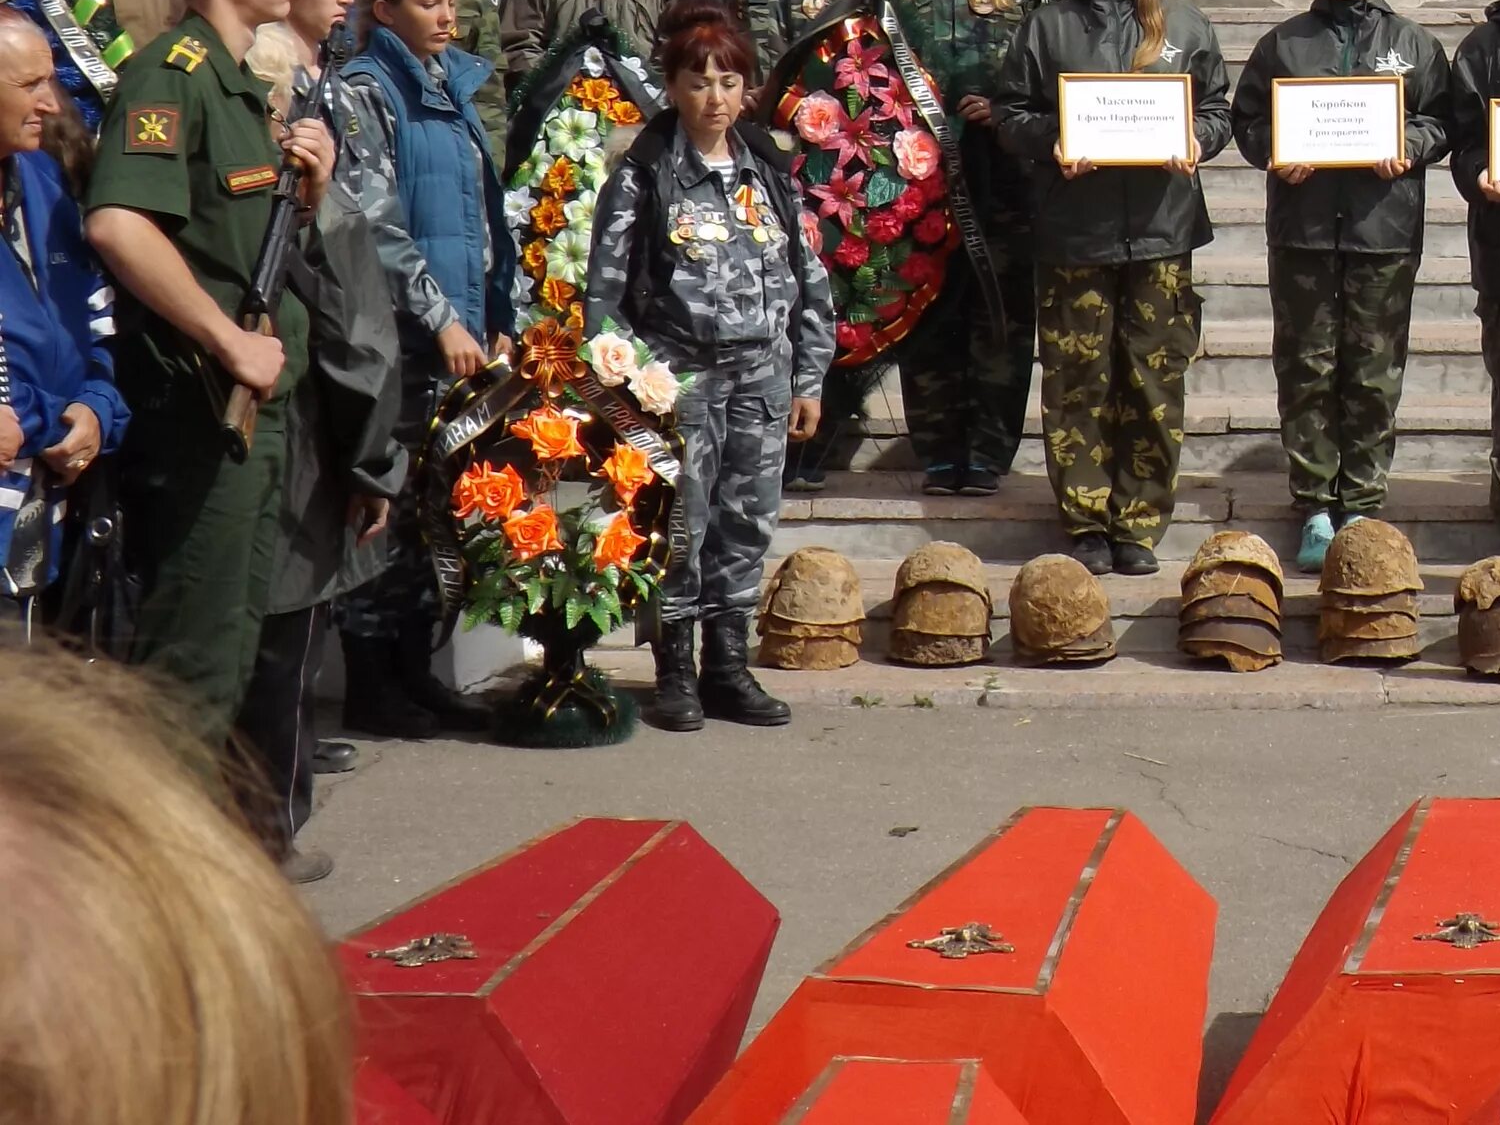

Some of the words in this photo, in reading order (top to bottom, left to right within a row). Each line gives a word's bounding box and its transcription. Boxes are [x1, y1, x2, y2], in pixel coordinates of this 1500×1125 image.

[893, 42, 941, 116] ПОИСКОВОГО
[1095, 95, 1157, 106] Максимов
[1310, 99, 1368, 111] Коробков
